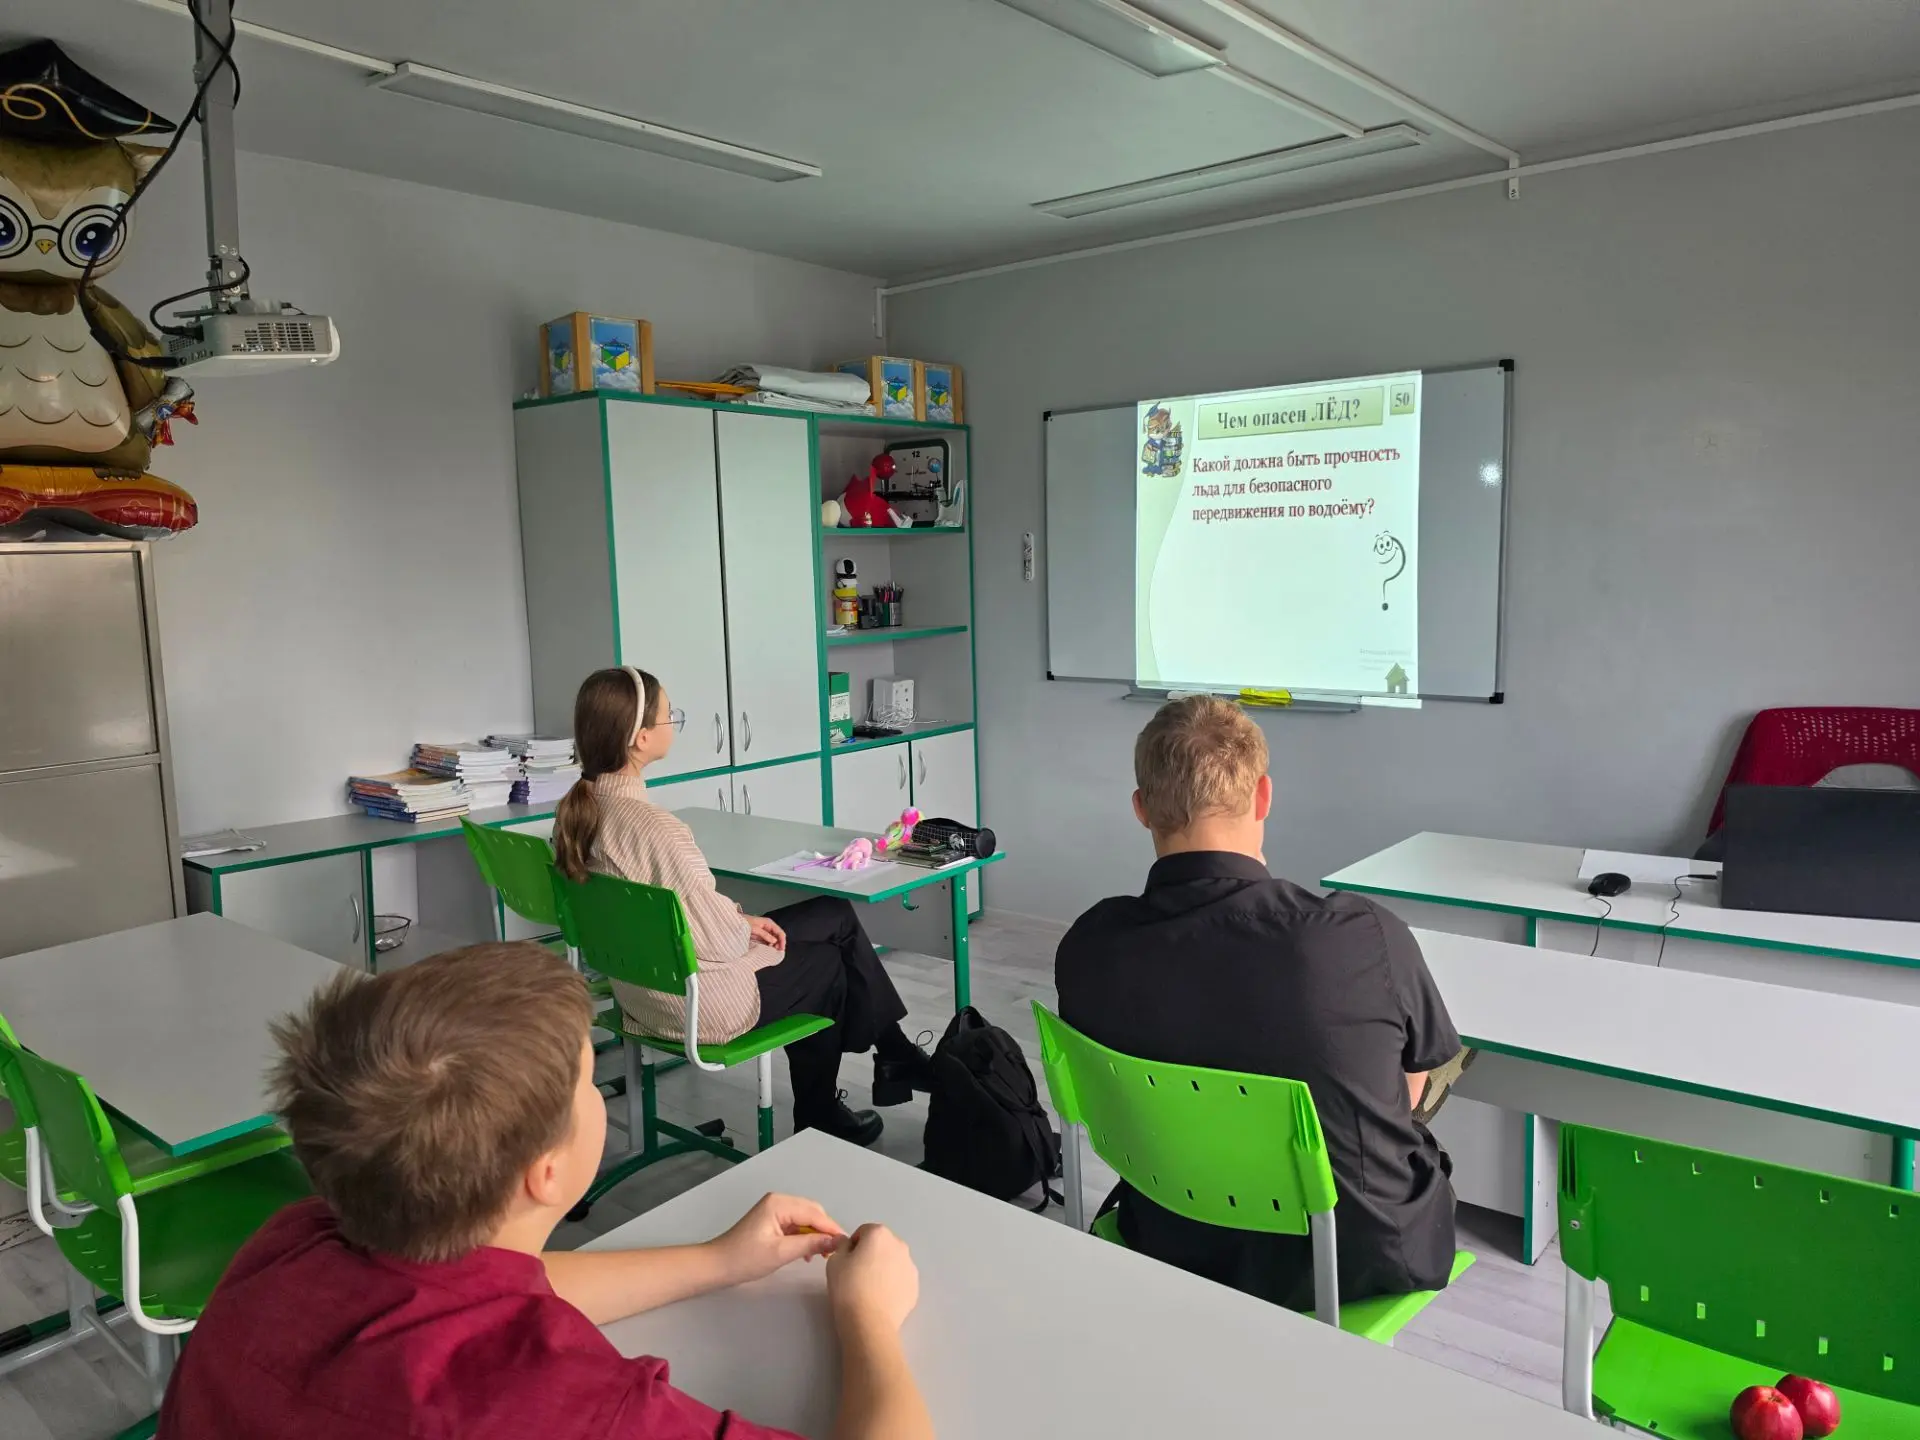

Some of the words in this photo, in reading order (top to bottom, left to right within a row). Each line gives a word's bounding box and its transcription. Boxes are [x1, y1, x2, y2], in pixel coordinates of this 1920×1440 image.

[1395, 392, 1410, 407] 50
[1217, 412, 1247, 429] Чем
[1252, 409, 1306, 427] опасен
[1311, 396, 1361, 422] ЛЁД?
[911, 450, 920, 458] 12
[1193, 455, 1230, 473] Какой
[1233, 456, 1283, 472] должна
[1287, 450, 1320, 467] быть
[1324, 446, 1400, 469] прочность
[1192, 483, 1220, 497] льда
[1223, 480, 1245, 497] для
[1249, 477, 1332, 494] безопасного
[1192, 505, 1285, 524] передвижения
[1288, 503, 1305, 517] по
[1309, 498, 1375, 519] водоёму?
